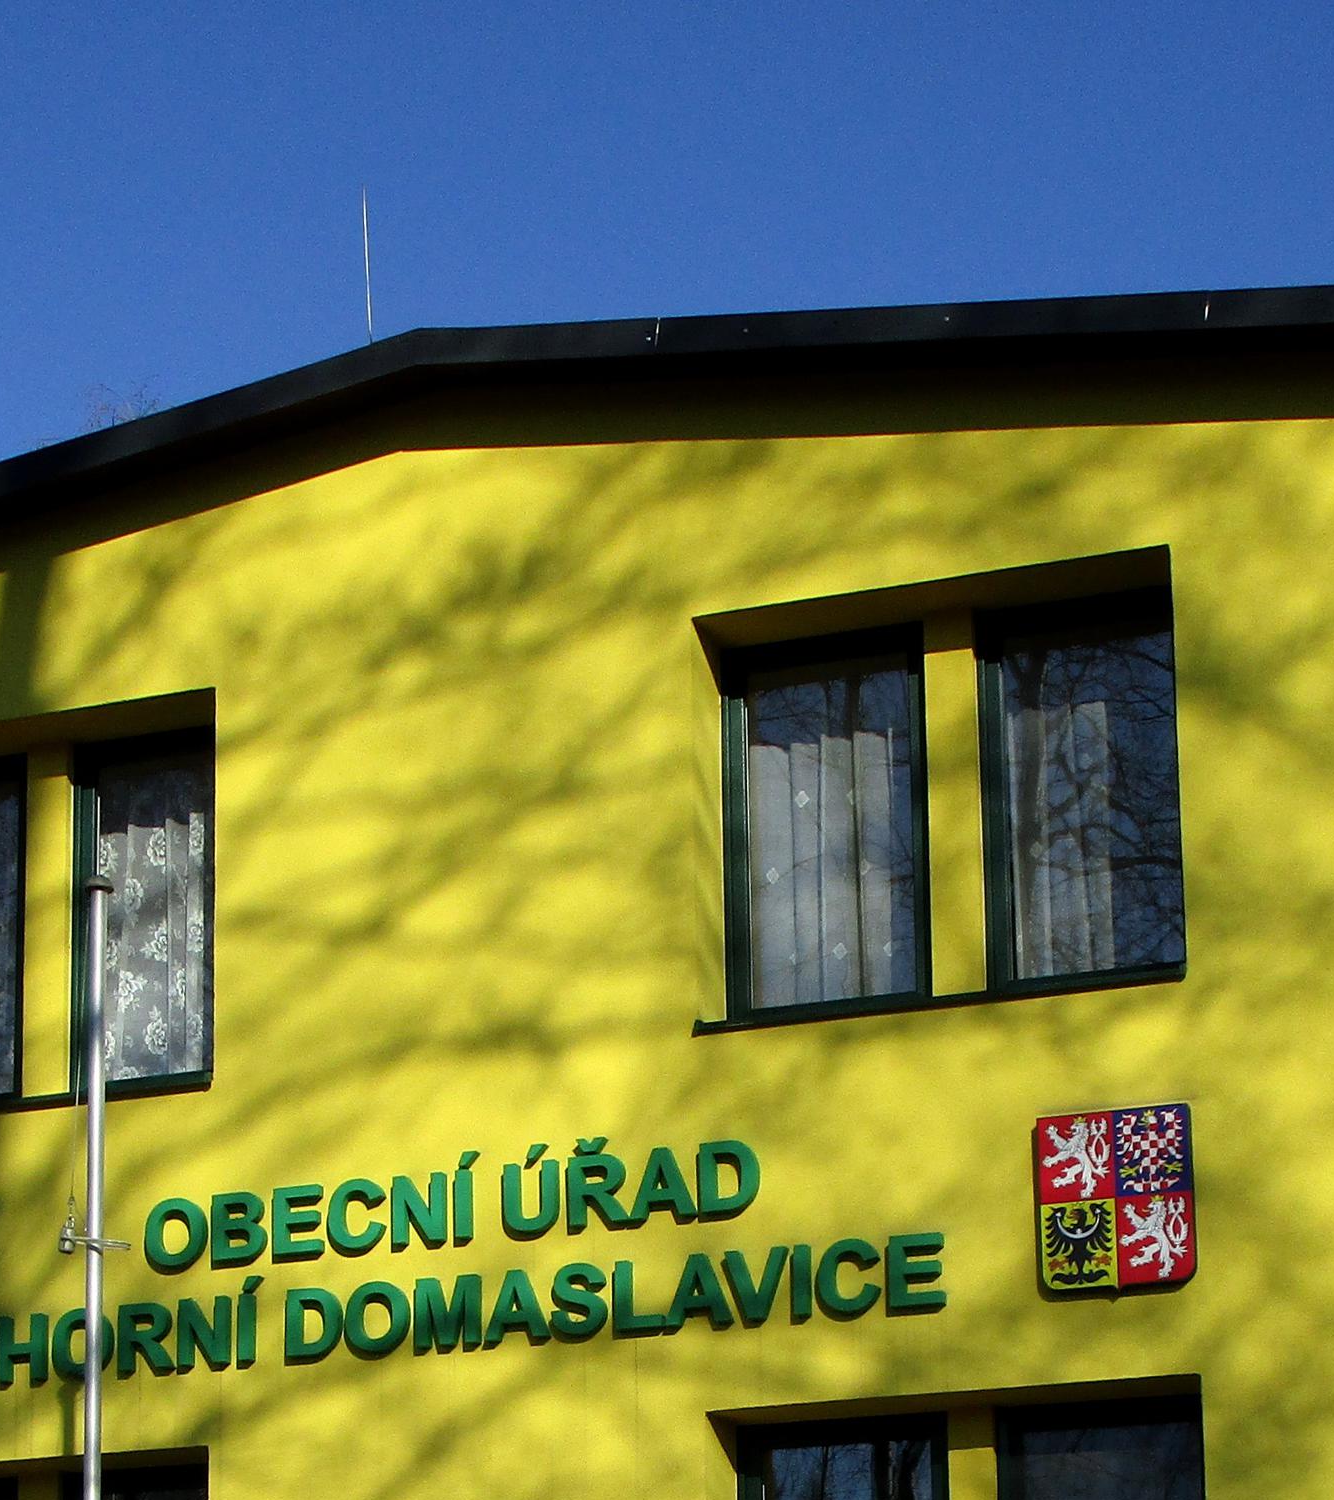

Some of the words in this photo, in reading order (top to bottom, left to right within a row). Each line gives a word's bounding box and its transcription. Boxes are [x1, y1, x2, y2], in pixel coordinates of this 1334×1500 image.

[144, 1150, 479, 1274] OBECNÍ
[501, 1136, 762, 1239] ÚŘAD
[282, 1231, 948, 1367] DOMASLAVICE
